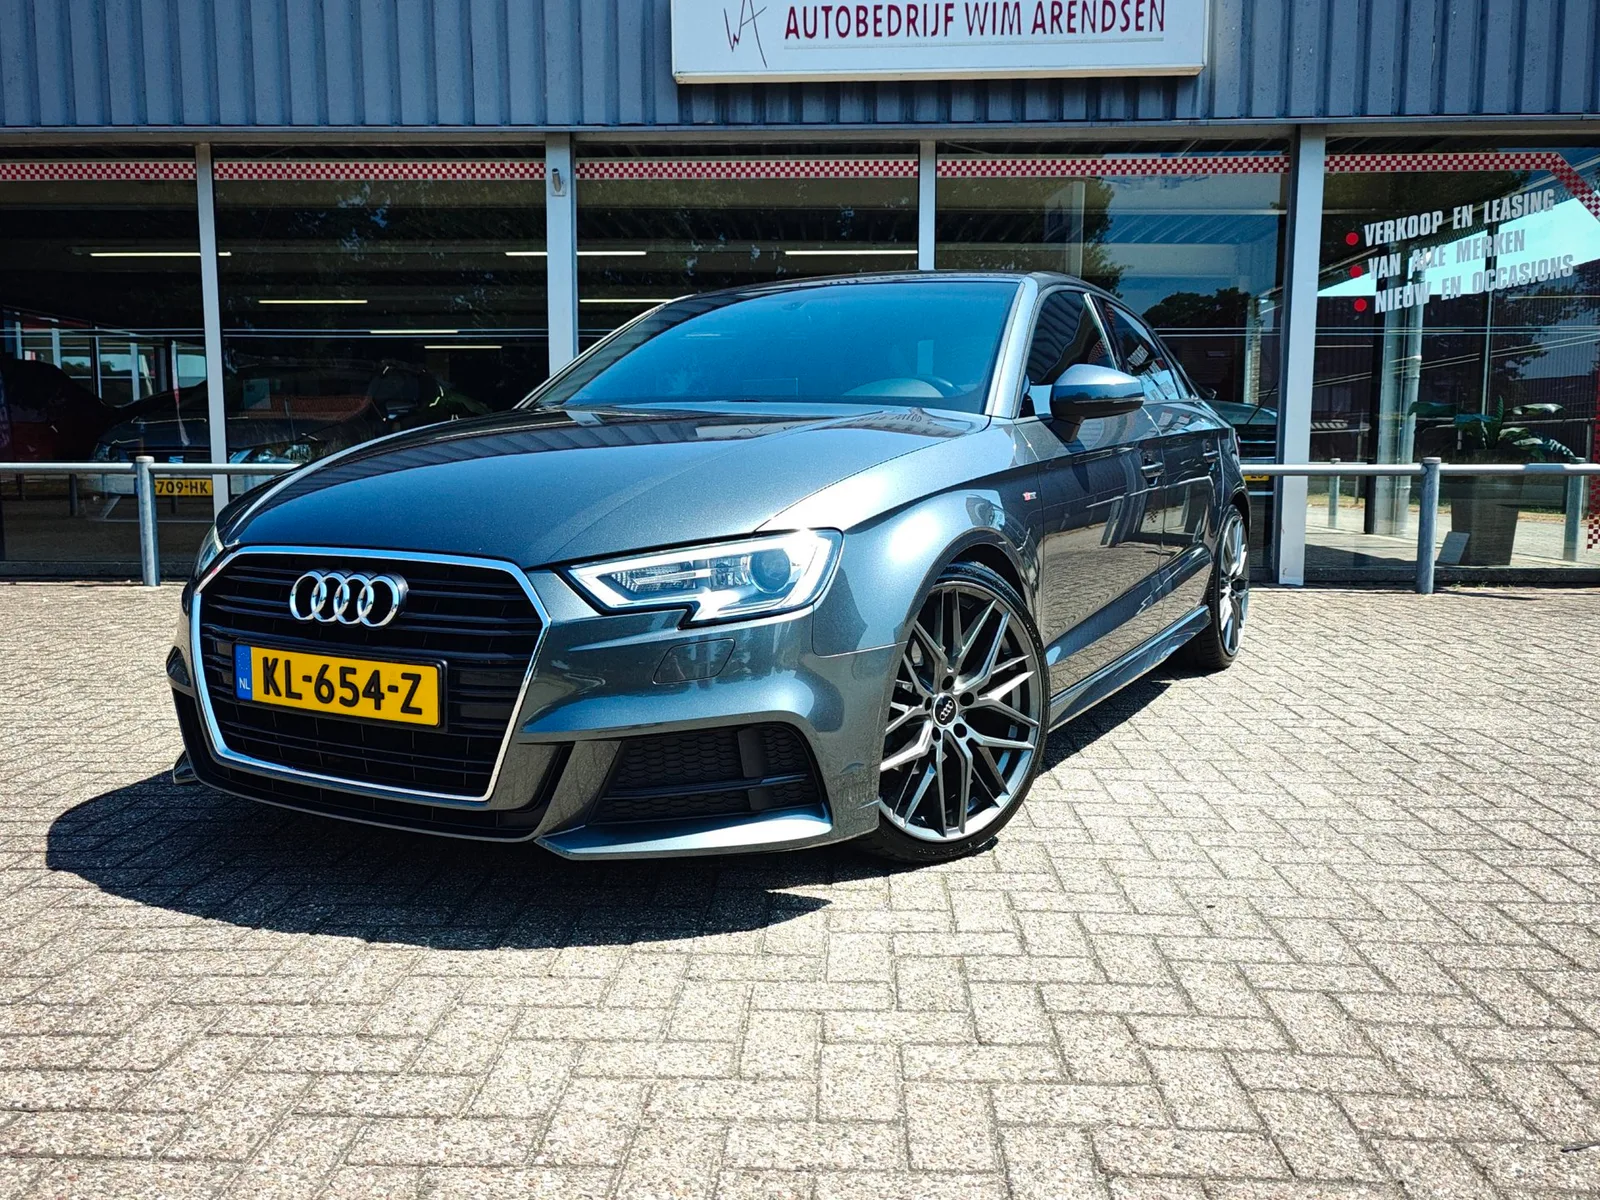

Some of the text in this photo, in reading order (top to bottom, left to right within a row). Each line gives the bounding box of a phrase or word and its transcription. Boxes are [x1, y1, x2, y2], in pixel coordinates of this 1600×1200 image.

[785, 0, 1165, 40] AUTOBEDRIJF WIM ARENDSEN
[1364, 188, 1555, 247] VERKOOP EN LEASING
[1368, 229, 1526, 280] VAN ALLE MERKEN
[1374, 254, 1574, 314] NIEUW EN OCCASIONS
[239, 676, 251, 690] NL
[262, 656, 423, 716] KL-654-Z
